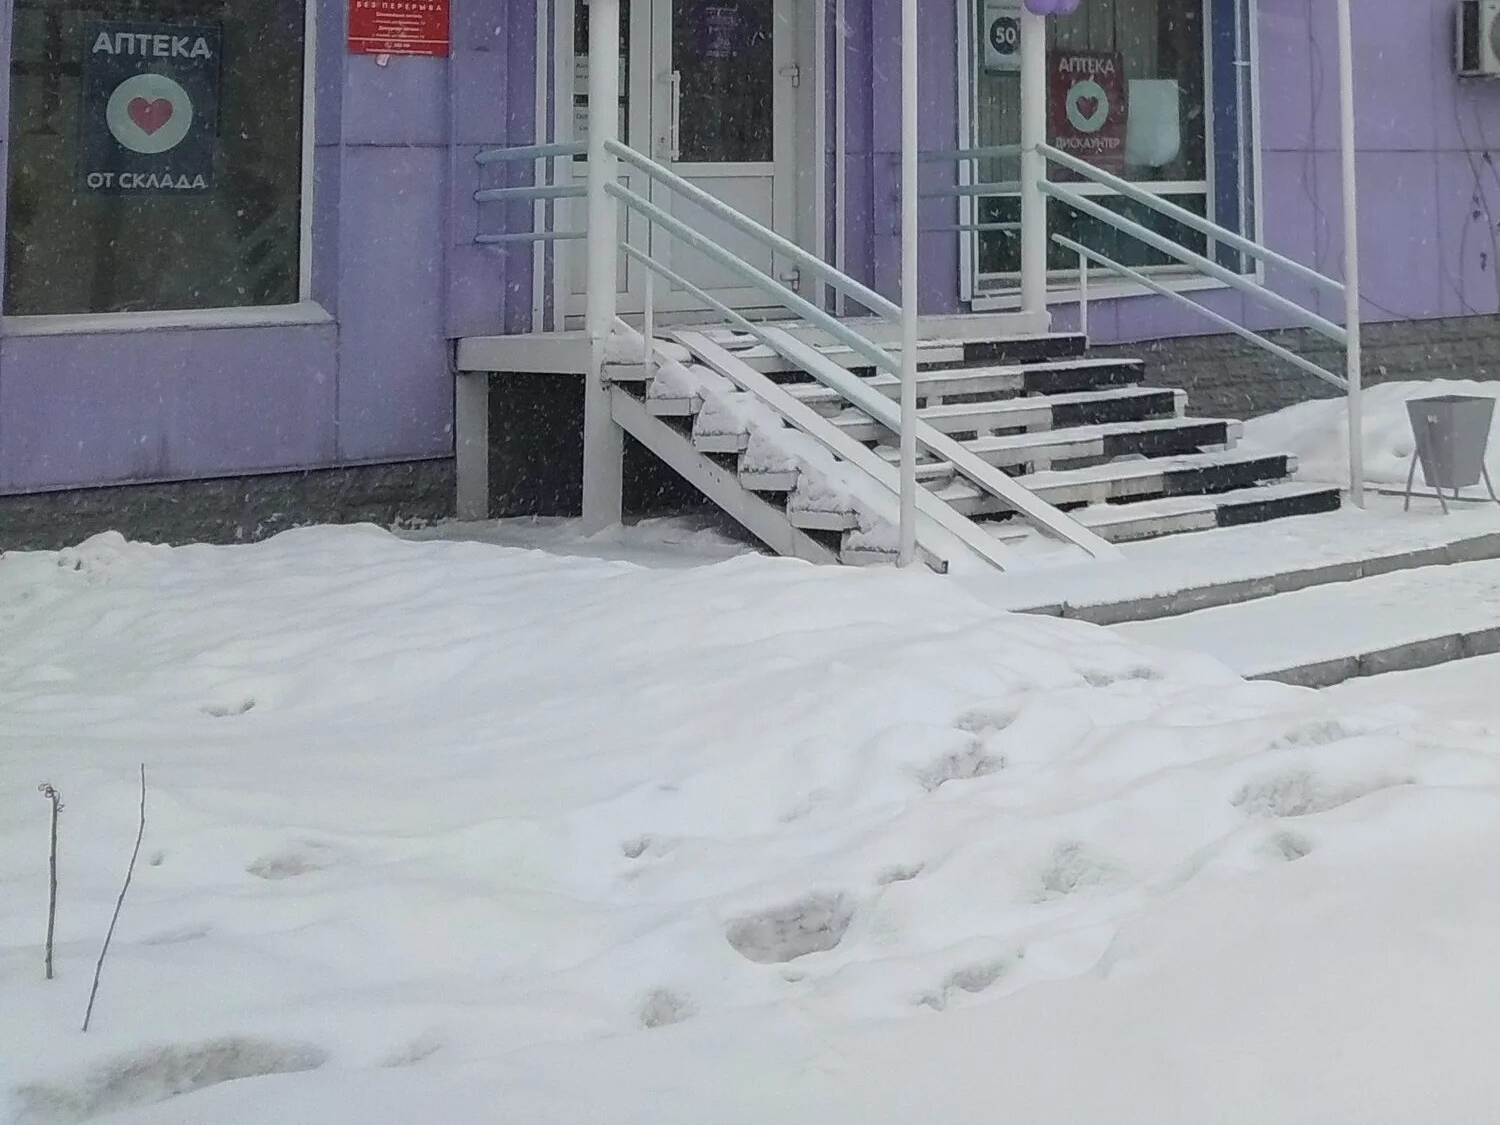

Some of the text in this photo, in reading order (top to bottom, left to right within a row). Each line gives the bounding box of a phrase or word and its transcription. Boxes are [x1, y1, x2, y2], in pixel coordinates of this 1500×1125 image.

[356, 1, 442, 12] БЕЗ ПЕРЕРЫВА
[92, 31, 213, 59] АПТЕКА
[1058, 57, 1115, 74] АПТЕКА
[1055, 137, 1121, 150] ДИСКАУНТЕР
[87, 172, 209, 190] ОТ СКЛАДА
